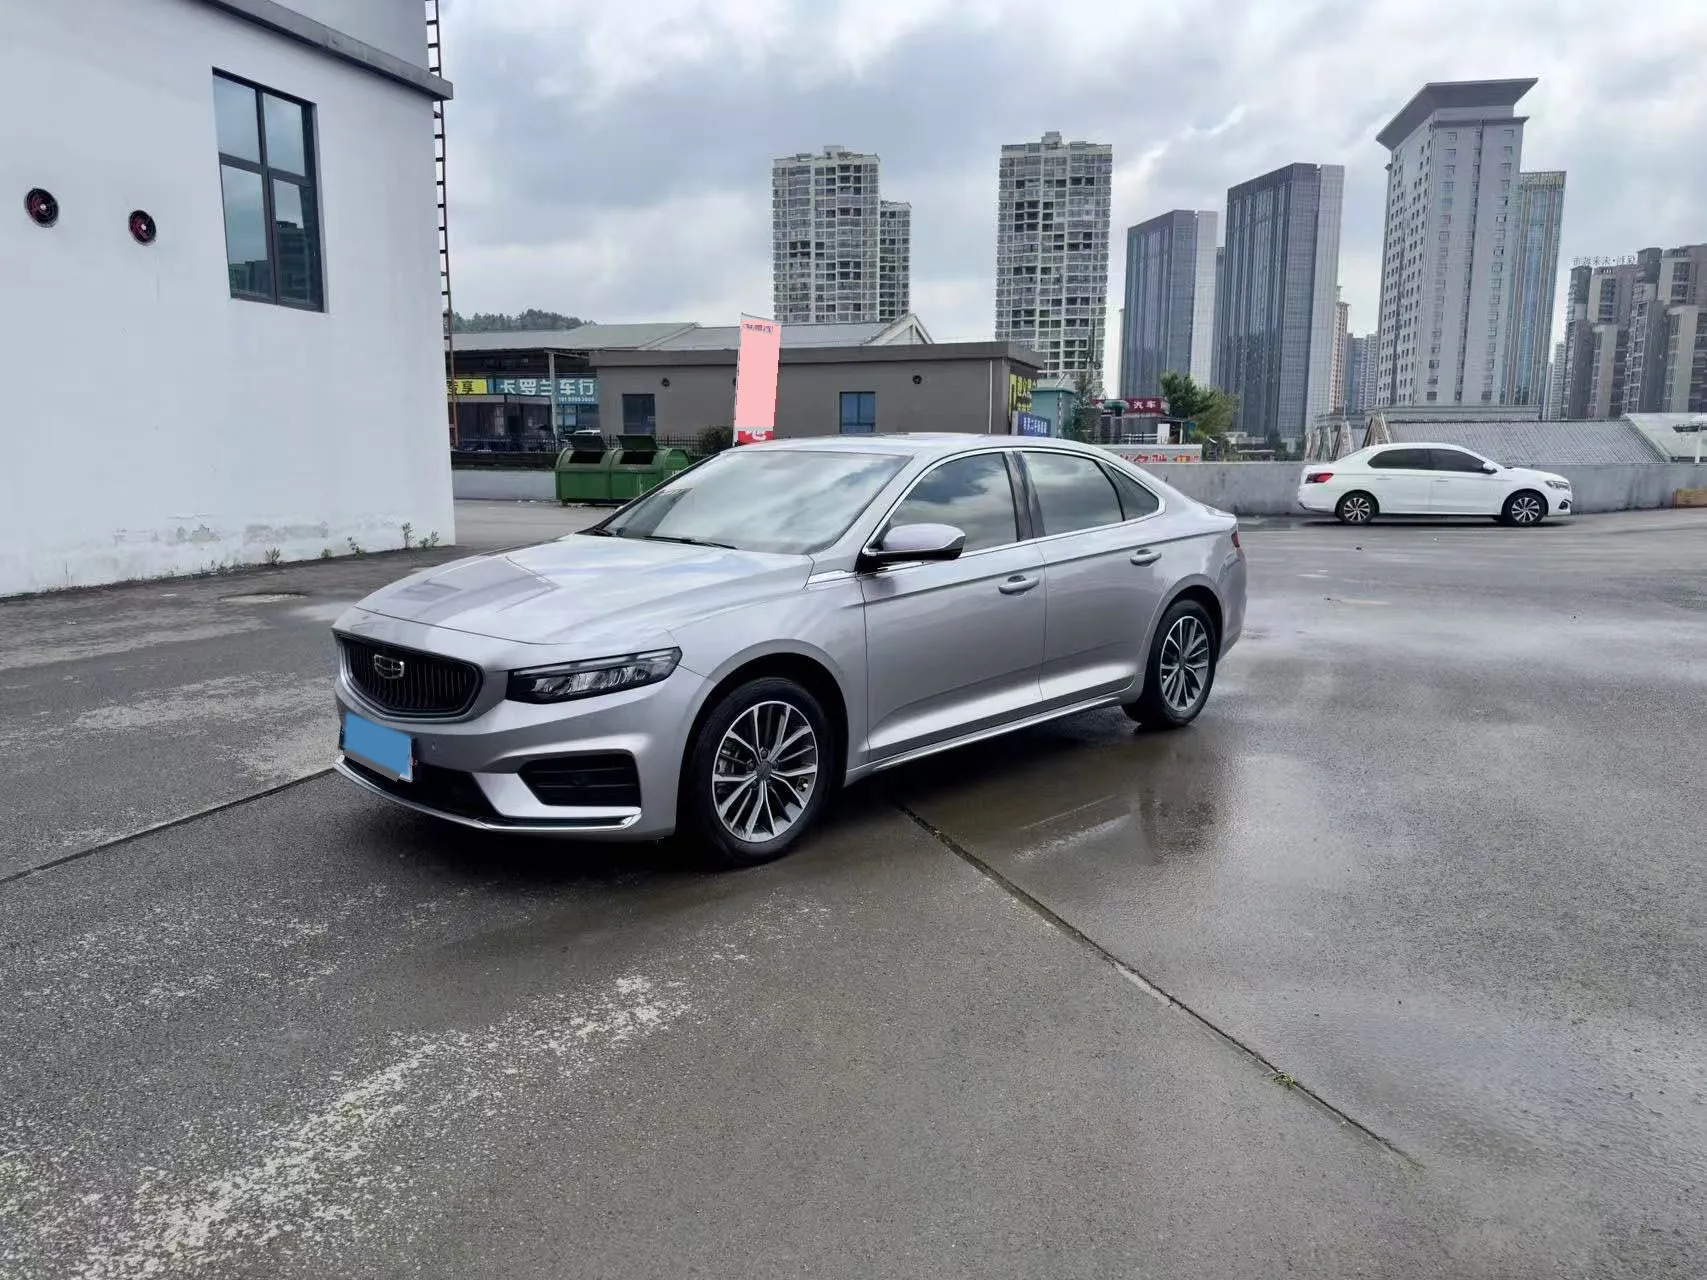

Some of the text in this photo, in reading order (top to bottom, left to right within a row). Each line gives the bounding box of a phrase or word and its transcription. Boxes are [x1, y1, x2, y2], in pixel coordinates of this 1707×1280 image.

[500, 378, 595, 396] 卡罗兰车行
